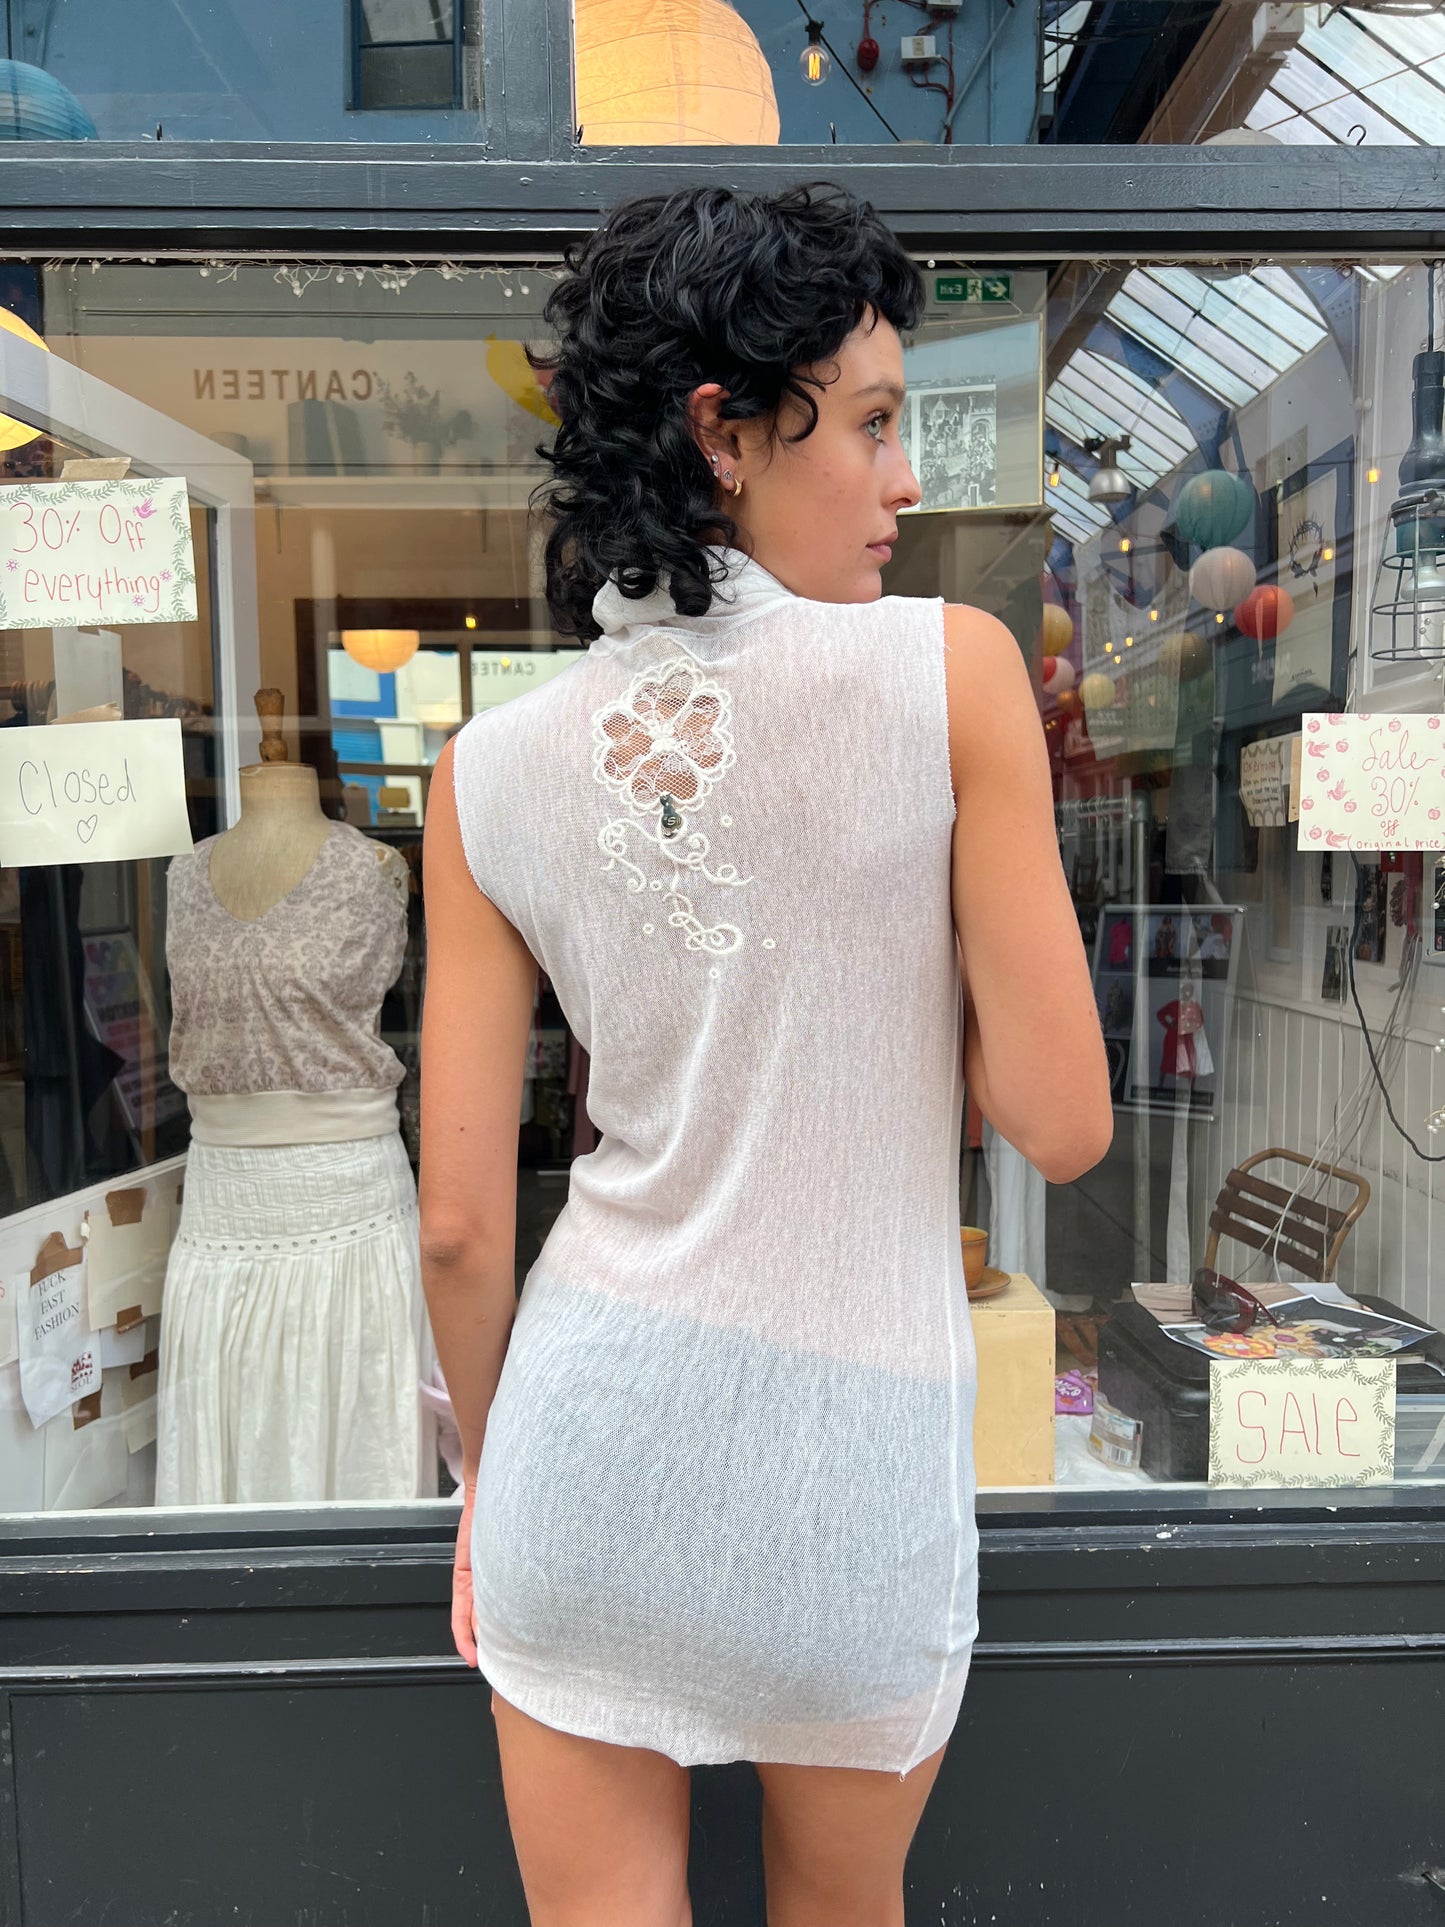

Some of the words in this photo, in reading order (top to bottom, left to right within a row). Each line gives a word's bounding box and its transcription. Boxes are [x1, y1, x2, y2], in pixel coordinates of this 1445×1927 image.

[9, 502, 81, 553] 30%
[99, 504, 146, 552] Off
[24, 567, 160, 613] everything
[1361, 728, 1439, 771] Sale
[19, 758, 136, 815] Closed
[1371, 776, 1420, 816] 30%
[1380, 819, 1399, 838] off
[38, 1271, 67, 1296] FUCK
[40, 1289, 66, 1315] FAST
[34, 1302, 80, 1341] FASHION
